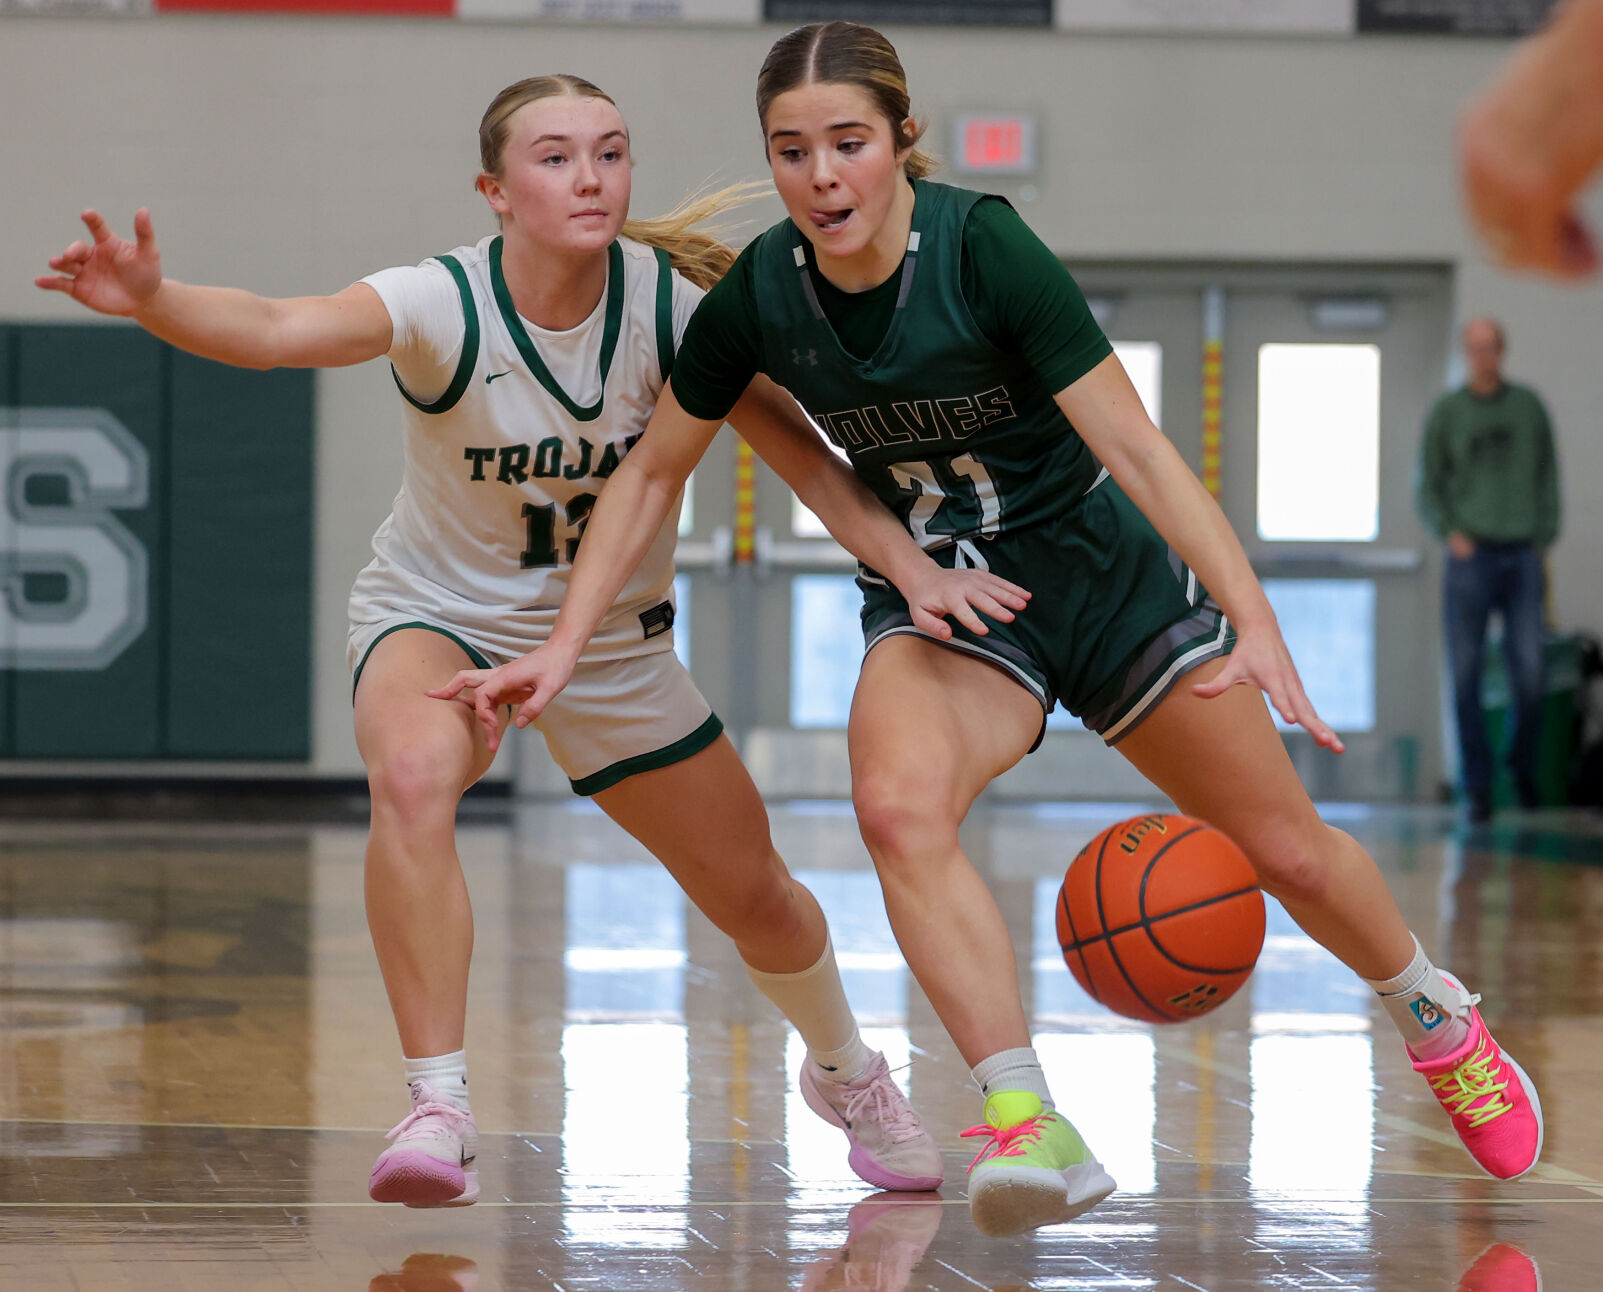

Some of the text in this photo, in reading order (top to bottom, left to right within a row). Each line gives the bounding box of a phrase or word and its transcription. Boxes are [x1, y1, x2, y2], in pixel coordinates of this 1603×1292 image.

[815, 385, 1016, 453] OLVES
[464, 431, 644, 485] TROJA
[888, 451, 1003, 551] 21
